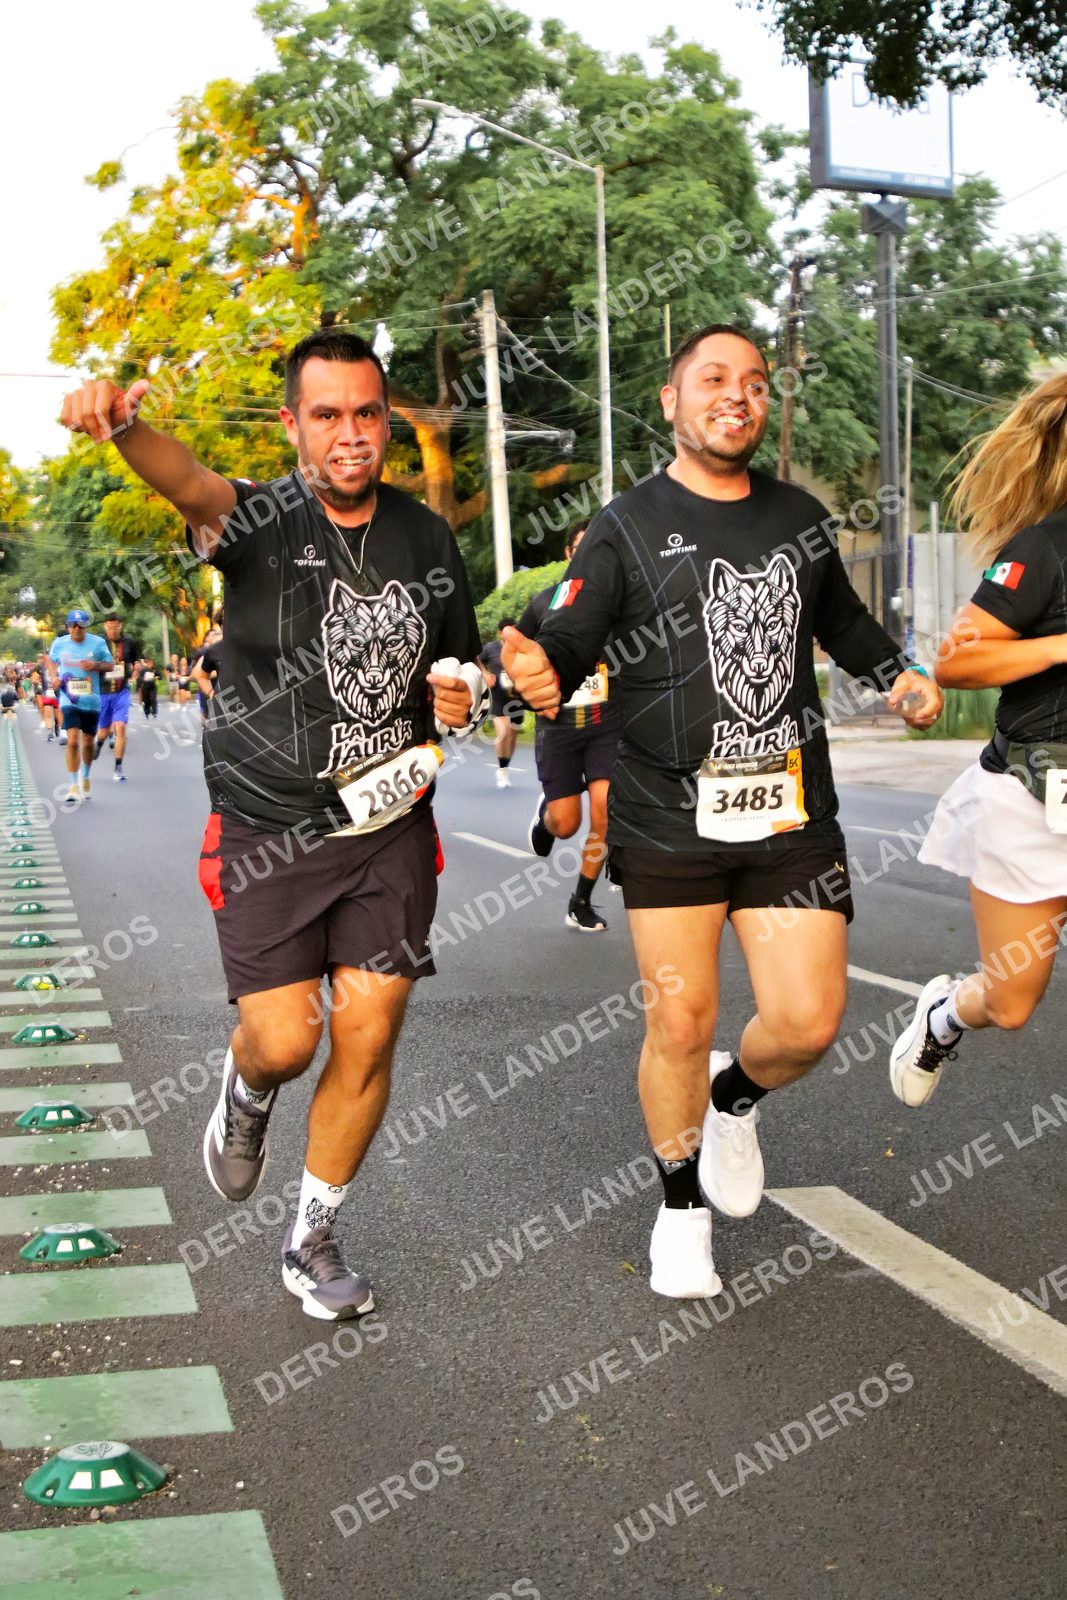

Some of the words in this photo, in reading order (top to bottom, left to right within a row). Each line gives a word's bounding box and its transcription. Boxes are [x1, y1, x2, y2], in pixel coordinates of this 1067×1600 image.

[660, 544, 698, 558] TOPTIME
[331, 722, 366, 746] LA
[713, 720, 748, 744] LA
[358, 758, 428, 818] 2866
[712, 783, 784, 814] 3485
